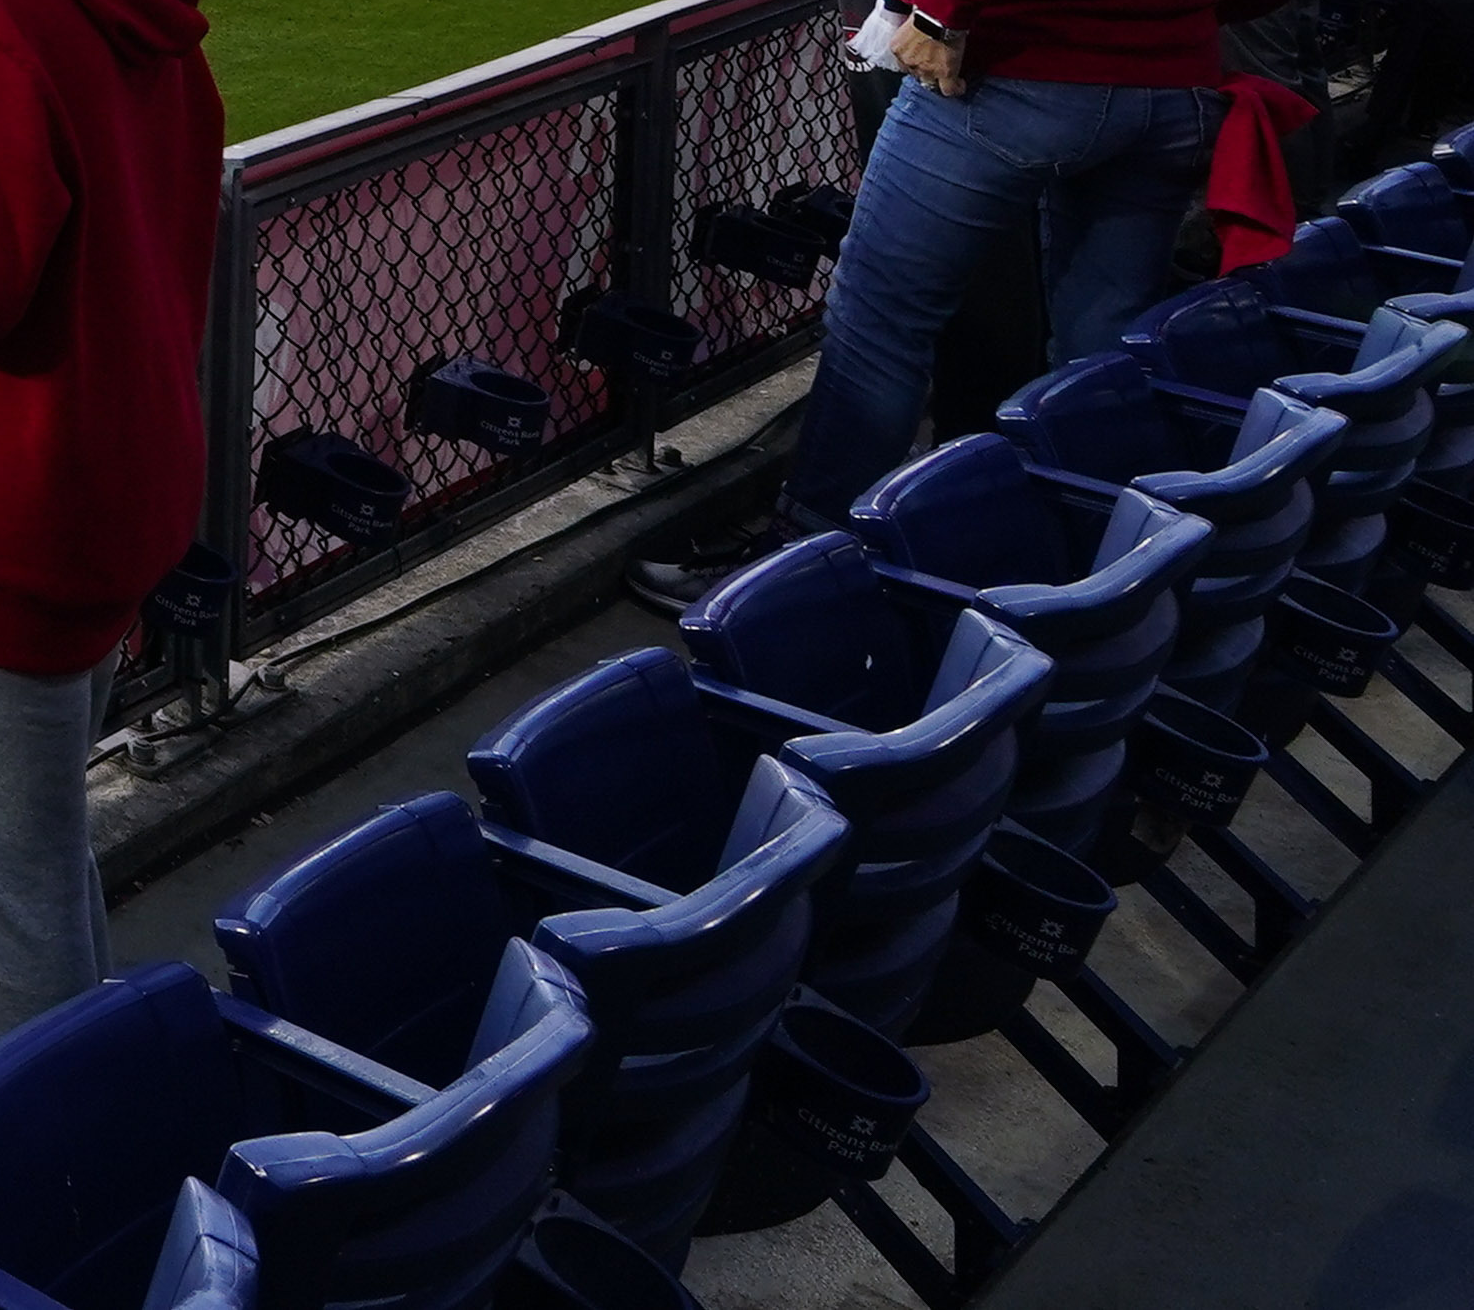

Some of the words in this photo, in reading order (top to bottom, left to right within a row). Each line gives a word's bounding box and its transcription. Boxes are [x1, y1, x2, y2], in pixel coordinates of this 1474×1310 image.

[480, 419, 520, 439] Citizens
[497, 435, 521, 447] Park
[330, 502, 371, 528] Citizens
[347, 522, 372, 536] Park
[154, 593, 197, 619] Citizens
[173, 613, 198, 627] Park
[1317, 666, 1350, 682] Park
[1155, 766, 1217, 804] Citizens
[1180, 790, 1215, 811] Park
[1017, 940, 1055, 964] Park
[796, 1107, 867, 1152] Citizens
[826, 1138, 866, 1164] Park
